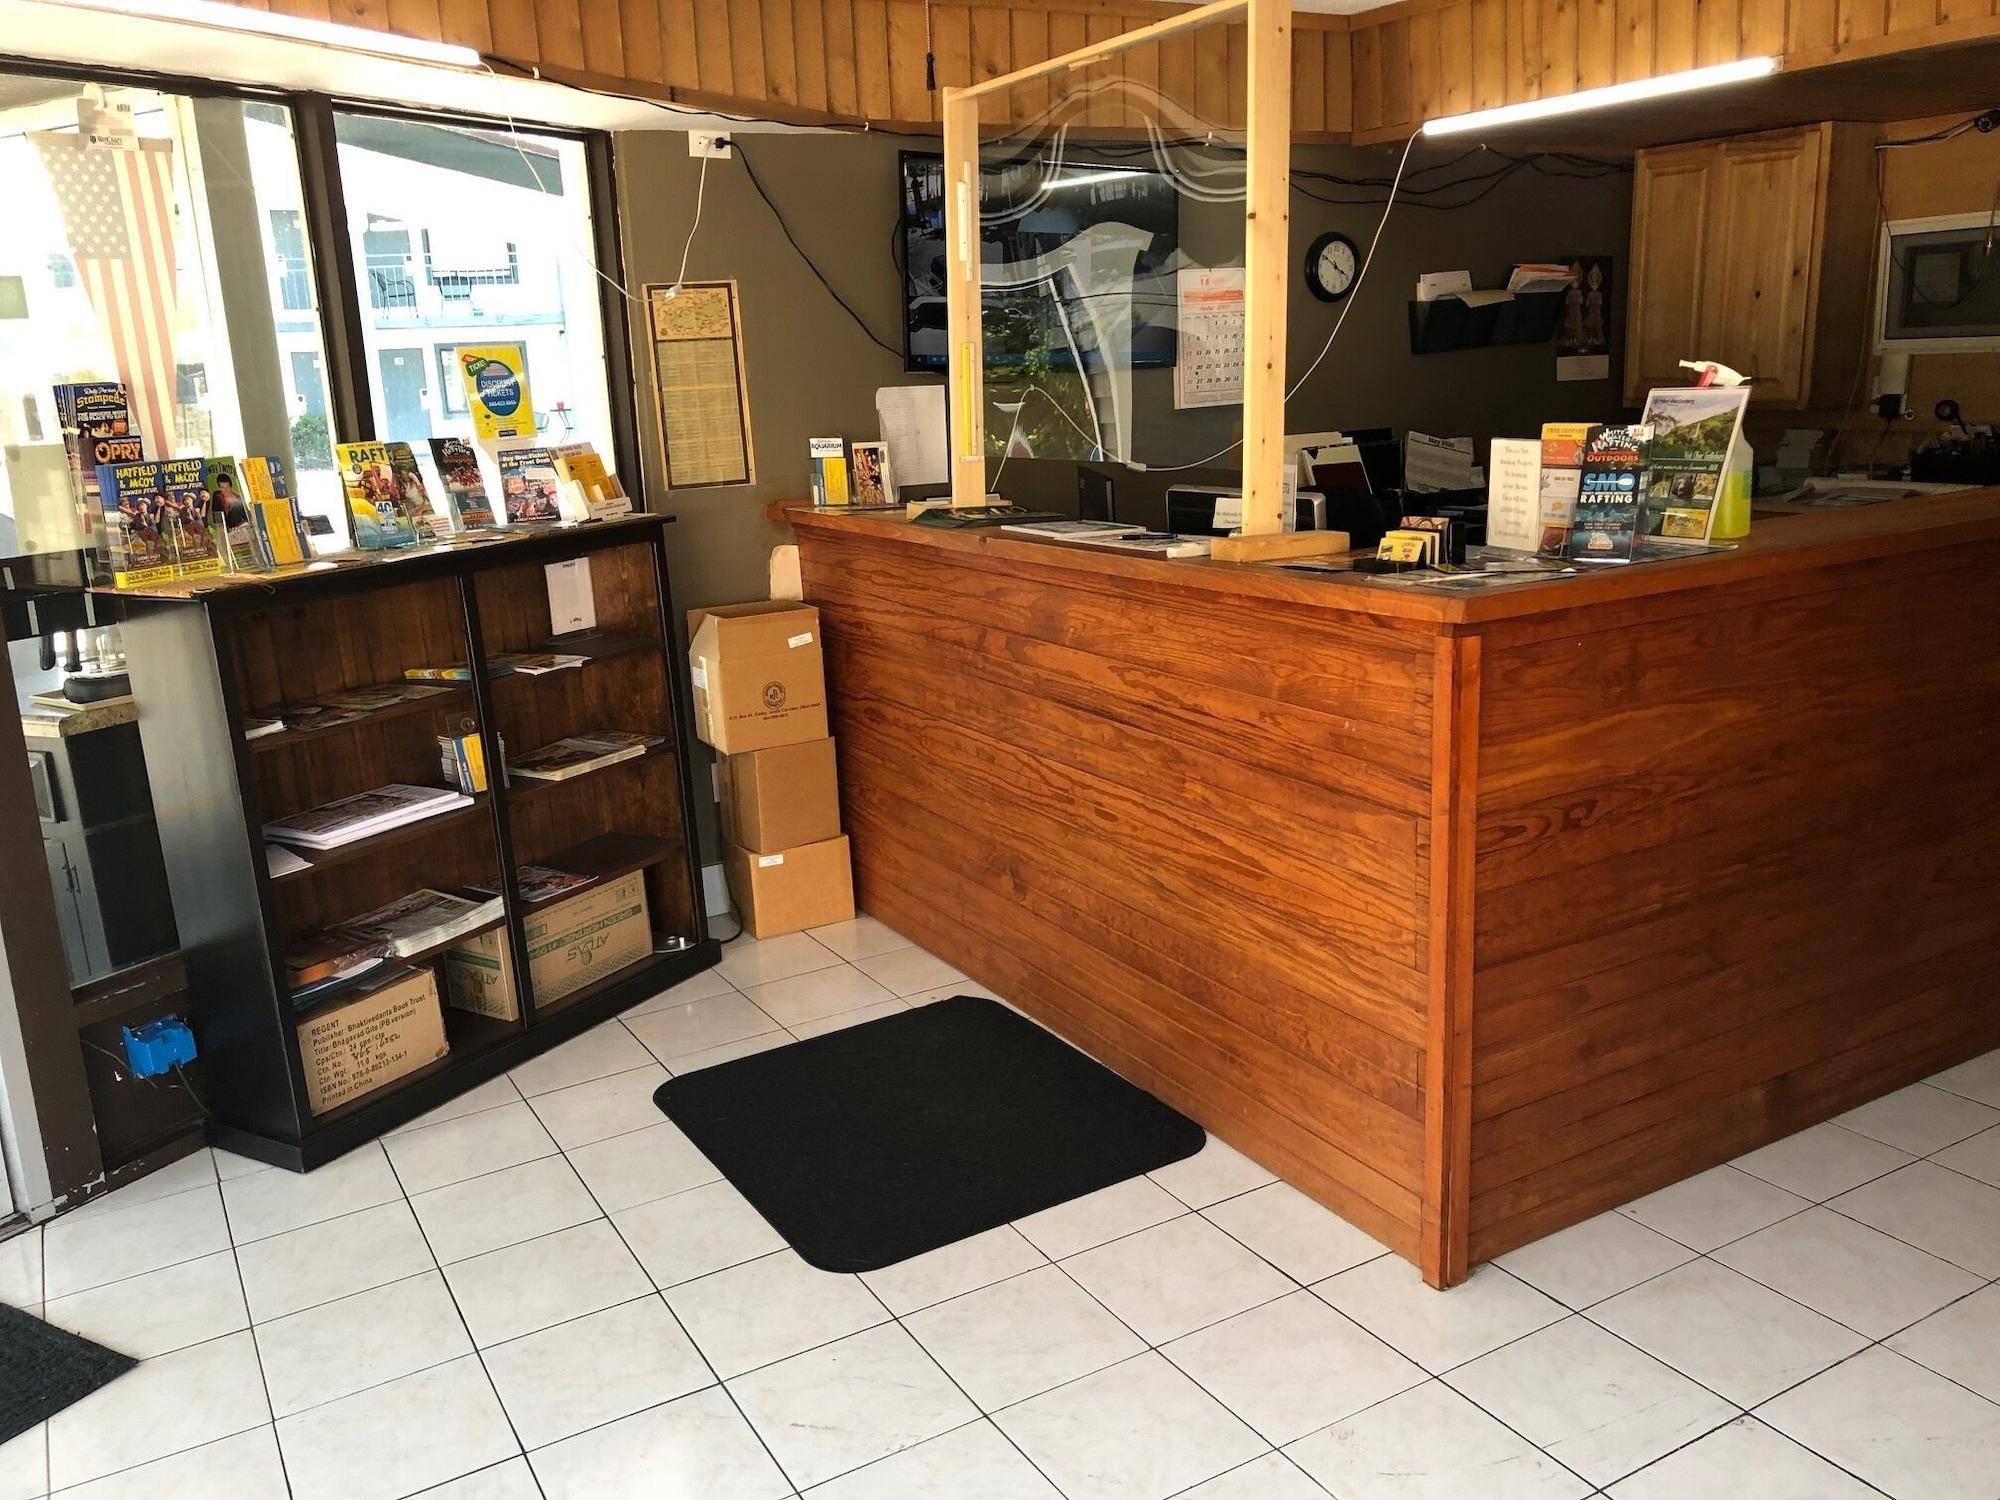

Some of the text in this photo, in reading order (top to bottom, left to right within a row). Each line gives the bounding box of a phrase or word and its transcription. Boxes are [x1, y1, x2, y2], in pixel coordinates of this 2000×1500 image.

[77, 391, 126, 409] Stampede
[95, 442, 141, 463] OPRY
[810, 442, 842, 450] AQUARIUM
[348, 448, 384, 464] RAFT
[1586, 454, 1639, 462] OUTDOORS
[116, 465, 158, 479] HATFIELD
[162, 460, 202, 474] HATFIELD
[1583, 472, 1636, 490] SMO
[1580, 494, 1634, 504] RAFTING
[567, 932, 610, 961] ATLAS
[347, 1009, 393, 1032] Bhaktivedanta
[393, 1001, 409, 1012] Book
[408, 994, 426, 1007] Trust
[312, 1019, 340, 1036] REGENT
[332, 1030, 364, 1048] Bhagavad
[390, 1008, 416, 1024] version)
[349, 1044, 358, 1052] 24
[320, 1083, 337, 1094] ISBN
[322, 1089, 346, 1104] Printed
[354, 1077, 373, 1090] China
